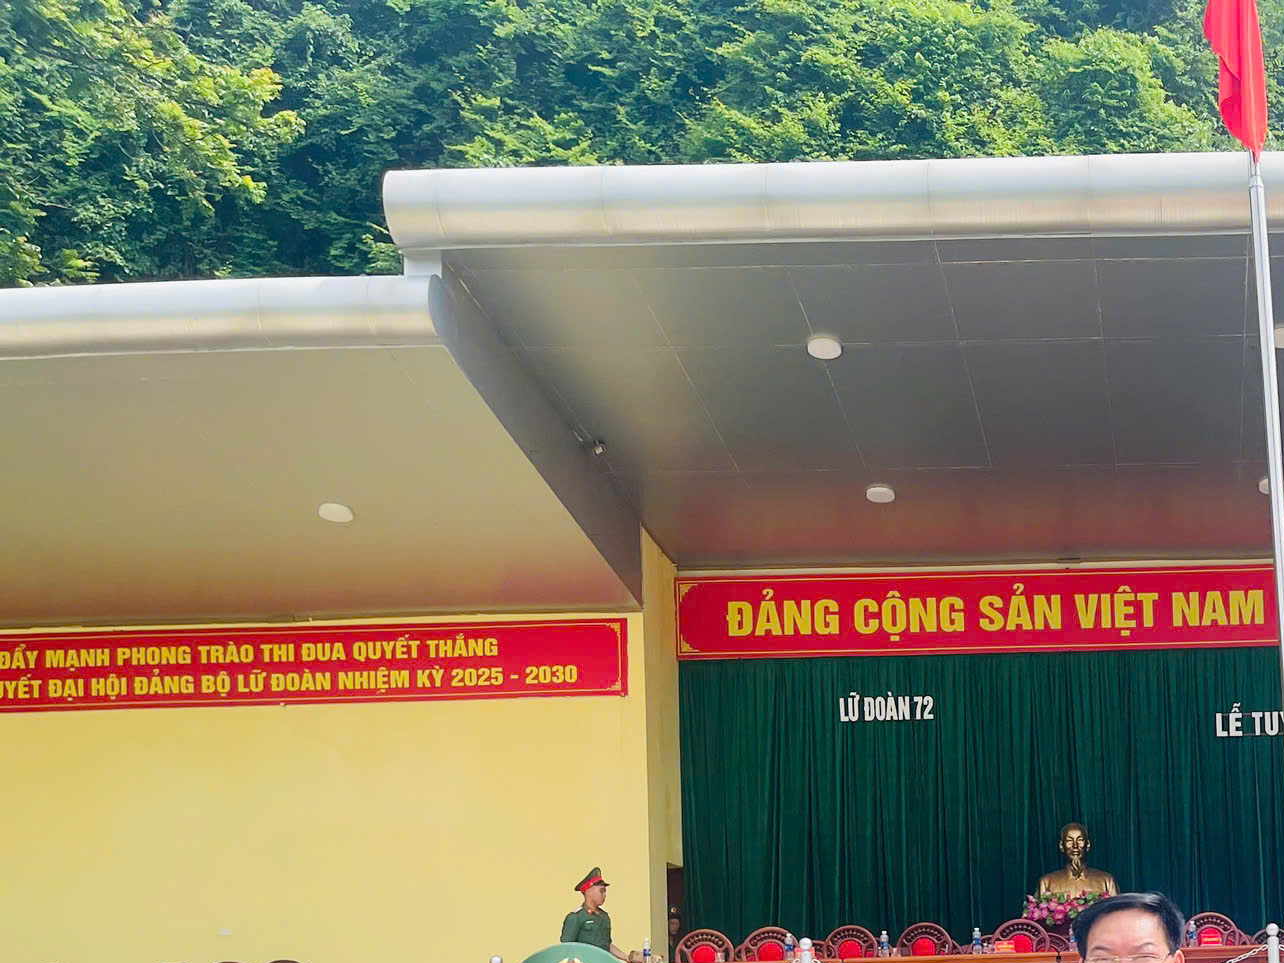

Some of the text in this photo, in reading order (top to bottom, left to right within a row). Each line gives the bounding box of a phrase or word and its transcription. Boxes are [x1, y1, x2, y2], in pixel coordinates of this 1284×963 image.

[727, 589, 839, 636] ĐẢNG
[854, 591, 964, 641] CỘNG
[980, 584, 1061, 631] SẢN
[1075, 586, 1158, 636] VIỆT
[1172, 590, 1264, 626] NAM
[46, 648, 109, 671] MẠNH
[117, 646, 191, 665] PHONG
[198, 642, 253, 663] TRÀO
[261, 644, 294, 662] THI
[301, 643, 345, 661] ĐUA
[353, 635, 420, 661] QUYẾT
[427, 633, 498, 658] THẮNG
[48, 679, 83, 701] ĐẠI
[91, 674, 127, 699] HỘI
[134, 669, 194, 694] ĐẢNG
[202, 671, 230, 696] BỘ
[238, 670, 266, 692] LỮ
[270, 669, 331, 691] ĐOÀN
[338, 667, 409, 694] NHIỆM
[417, 666, 444, 687] KỲ
[451, 668, 503, 686] 2025
[526, 665, 577, 684] 2030
[840, 692, 933, 721] LỮ ĐOÀN 72
[1216, 703, 1242, 736] LỄ
